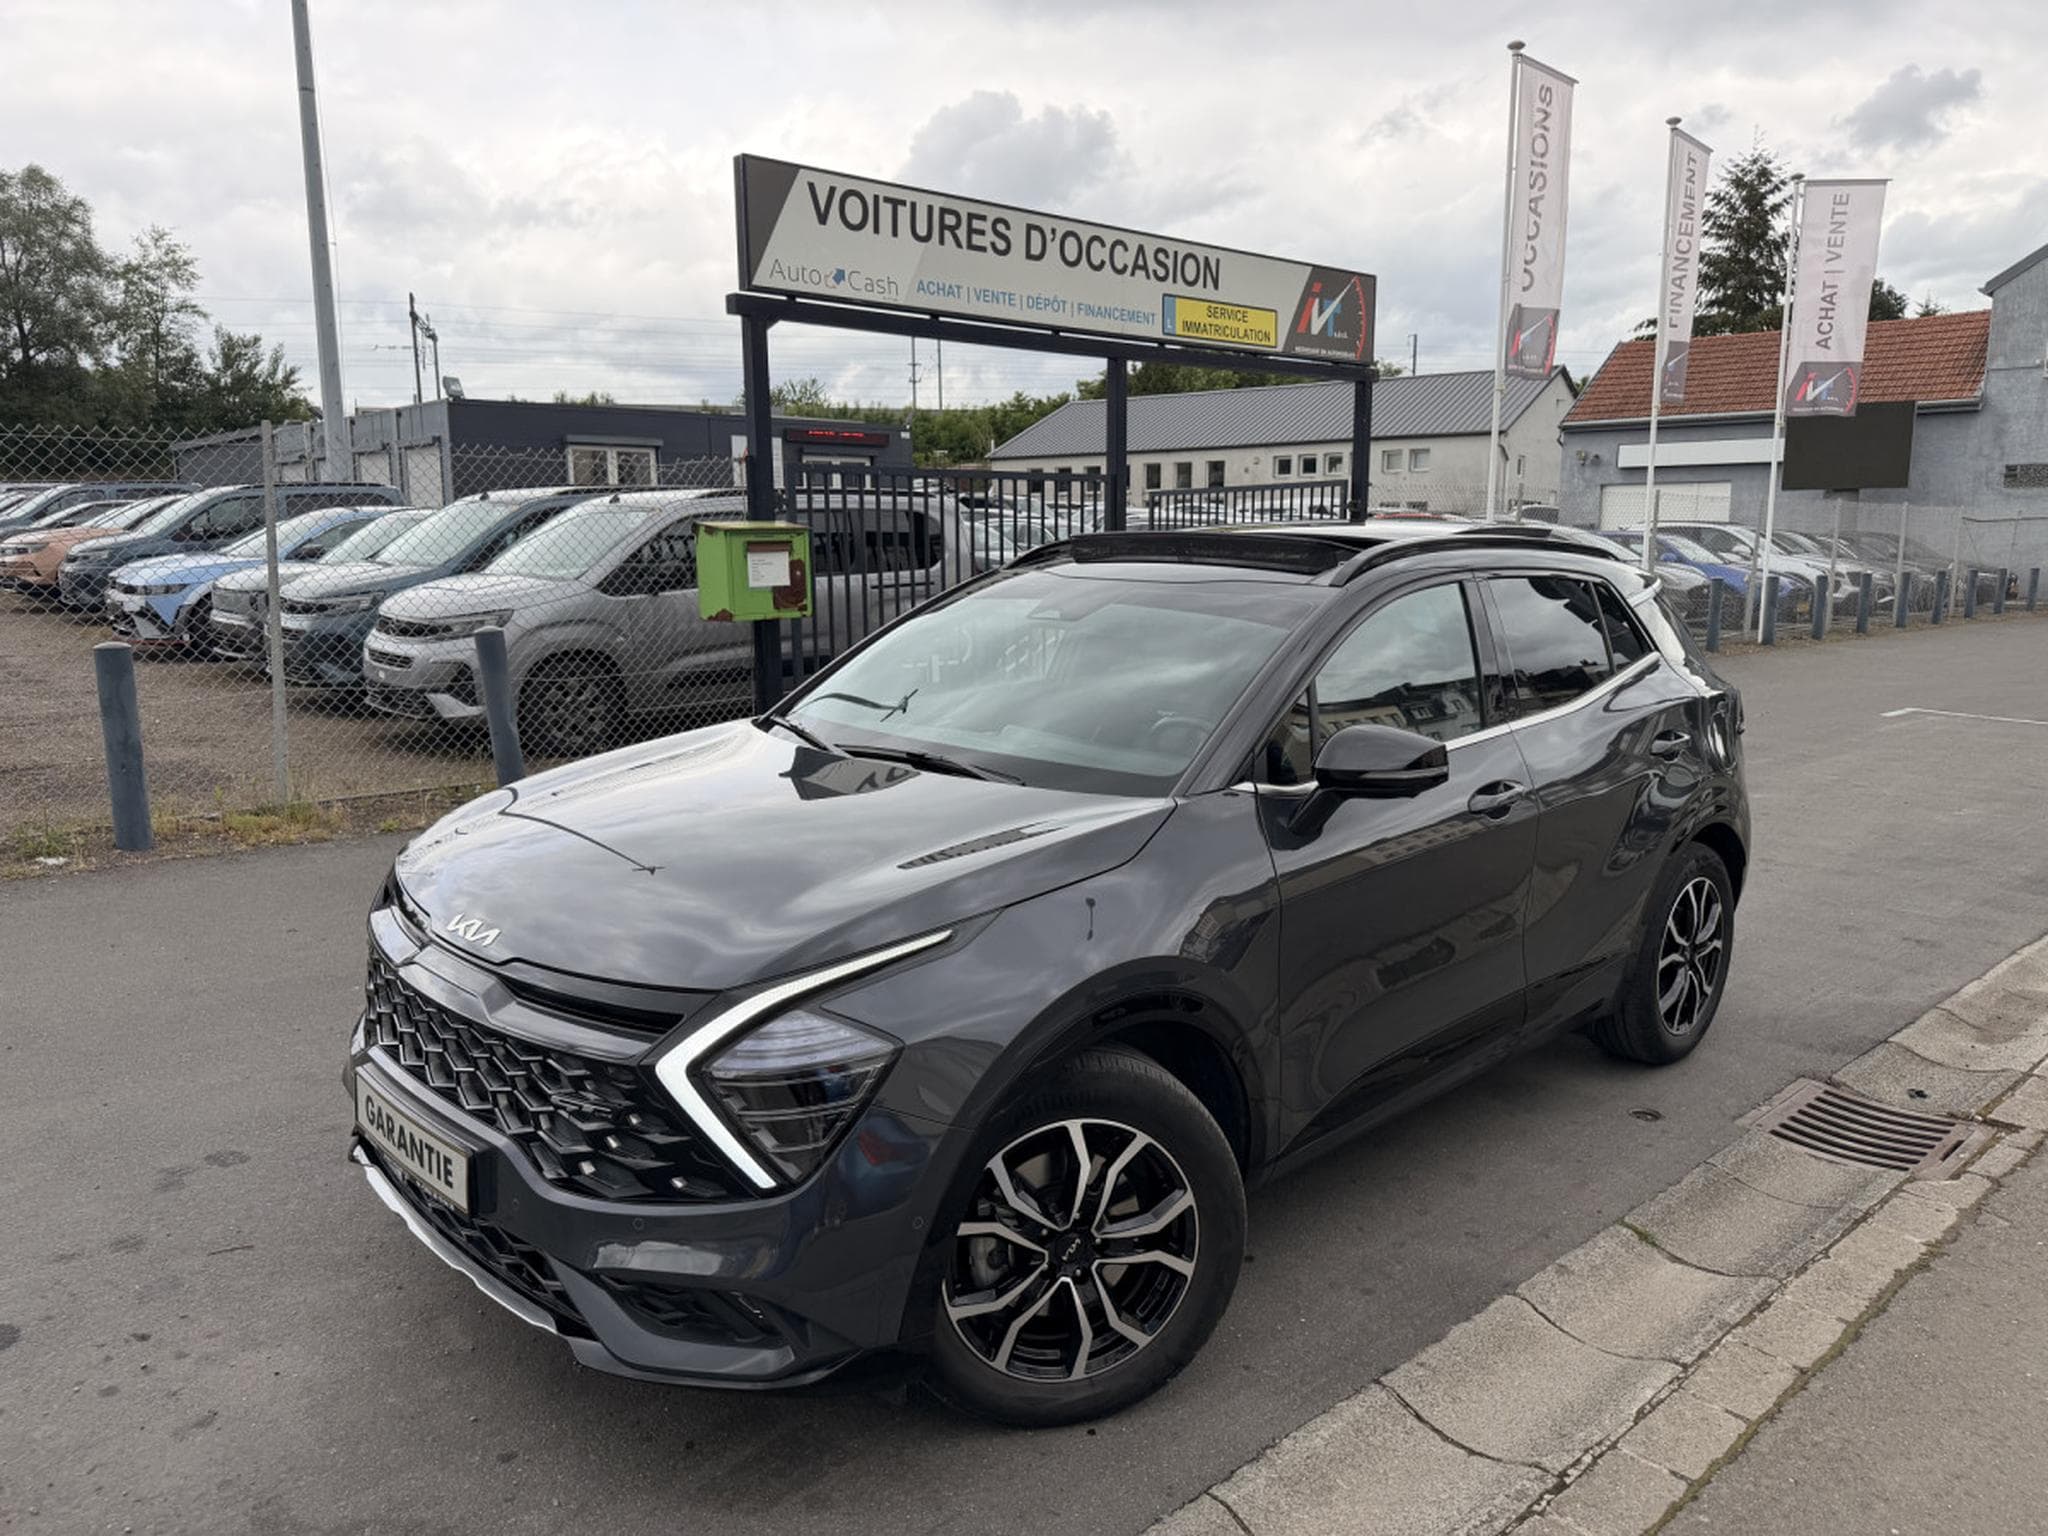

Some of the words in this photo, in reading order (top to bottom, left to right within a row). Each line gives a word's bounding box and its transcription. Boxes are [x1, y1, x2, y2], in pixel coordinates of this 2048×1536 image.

[807, 182, 1012, 257] VOITURES
[1025, 222, 1221, 291] D'OCCASION
[1825, 193, 1850, 264] VENTE
[769, 258, 822, 286] Auto
[847, 271, 899, 297] Cash
[916, 279, 963, 300] ACHAT
[974, 289, 1016, 308] VENTE
[1026, 294, 1067, 314] DÉPÔT
[1077, 302, 1157, 327] FINANCEMENT
[1206, 304, 1249, 324] SERVICE
[1815, 281, 1839, 350] ACHAT
[1182, 320, 1271, 343] IMMATRICULATION
[446, 912, 502, 948] KIA
[365, 1094, 454, 1190] GARANTIE
